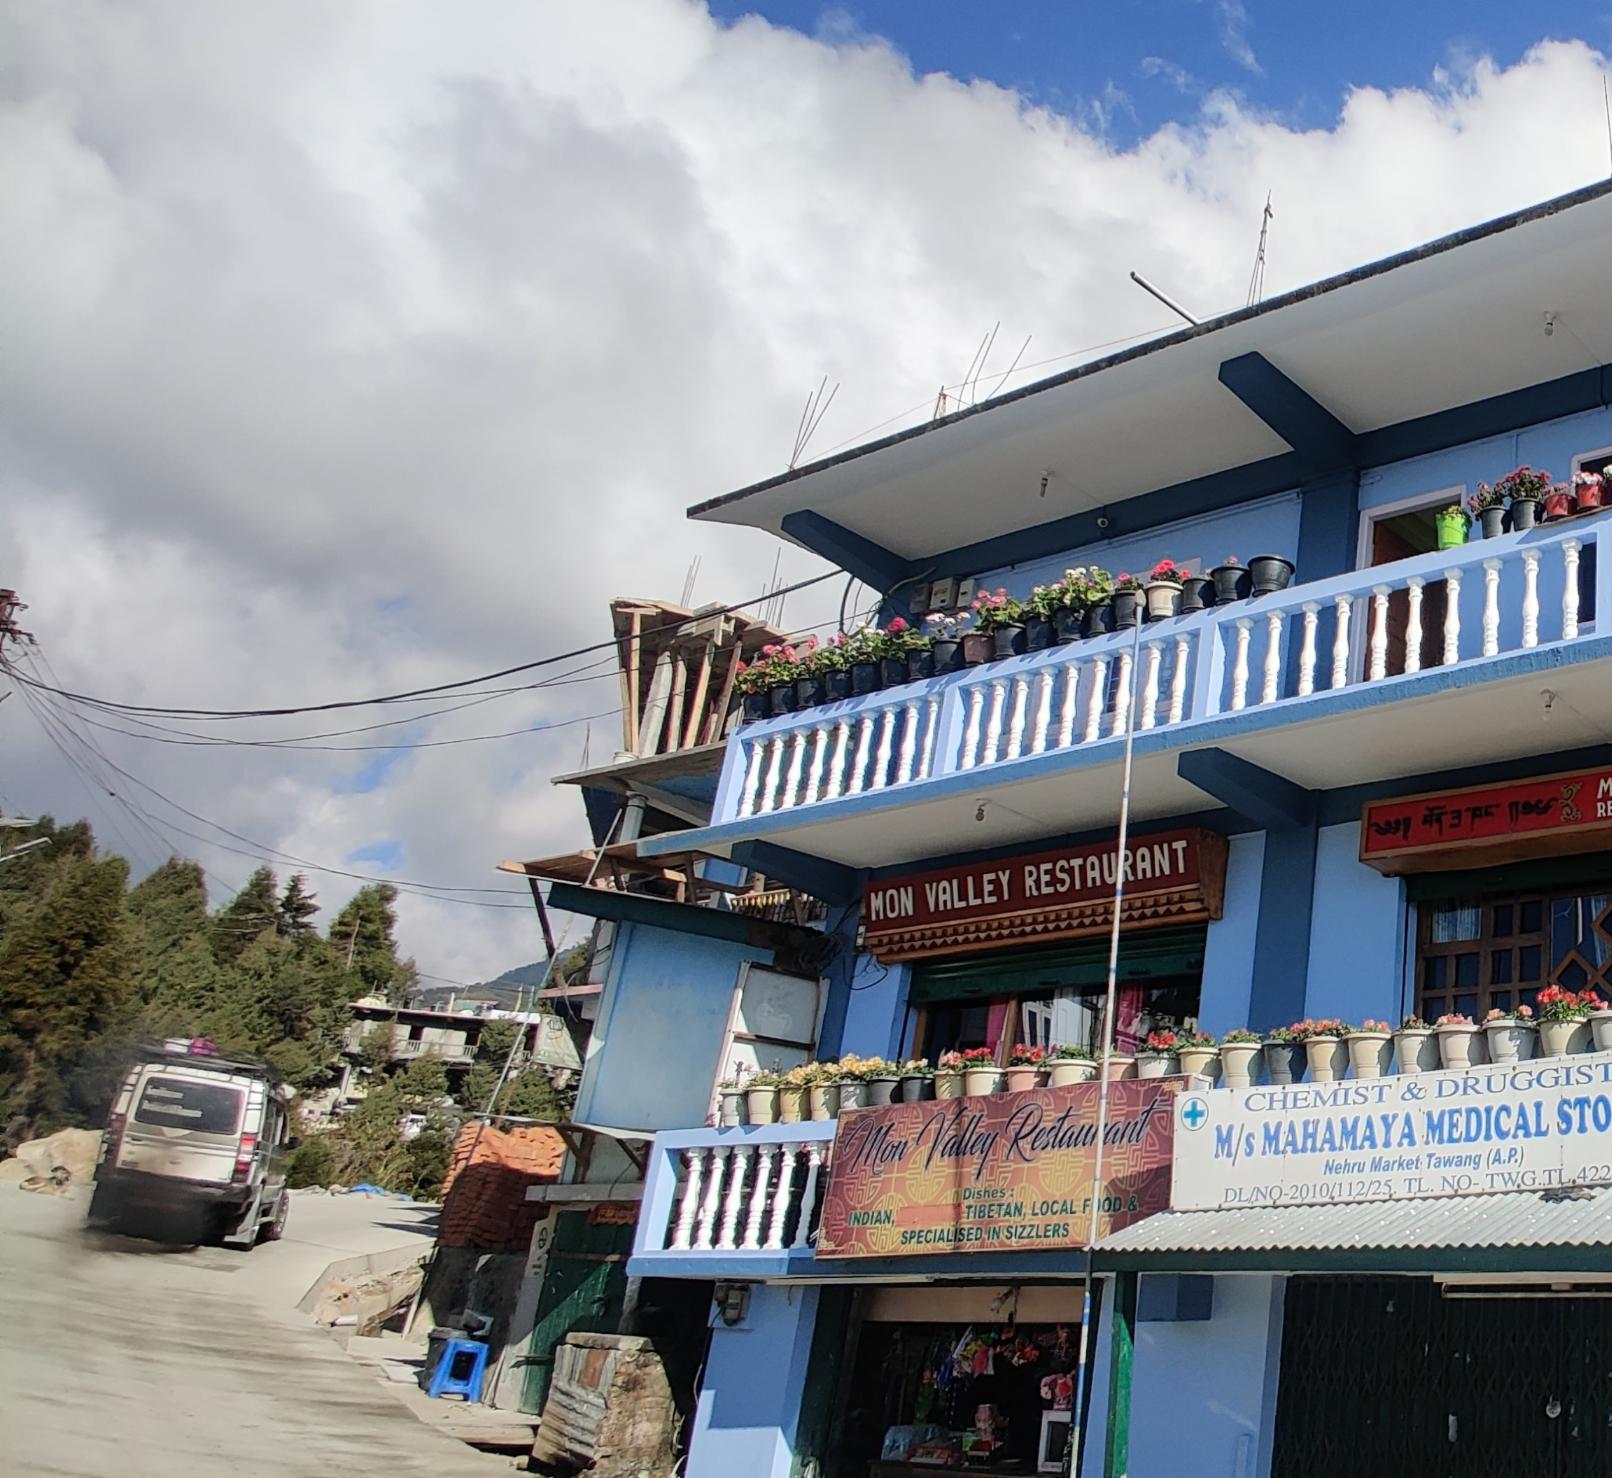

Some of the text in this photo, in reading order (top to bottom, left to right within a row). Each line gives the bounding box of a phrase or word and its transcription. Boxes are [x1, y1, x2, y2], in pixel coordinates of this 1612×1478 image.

[870, 839, 1188, 921] MON VALLEY RESTAURANT
[1244, 1083, 1392, 1112] CHEMIST
[1400, 1081, 1427, 1101] &
[843, 1117, 909, 1176] Mon
[916, 1106, 999, 1181] Valley
[1214, 1122, 1255, 1167] M/s
[1261, 1111, 1417, 1156] MAHAMAYA
[1424, 1100, 1550, 1146] MEDICAL
[1323, 1159, 1366, 1175] Nehru
[1370, 1154, 1421, 1172] Market
[1426, 1152, 1482, 1169] Tawang
[1031, 1200, 1077, 1216] LOCAL
[1083, 1196, 1122, 1214] FOD
[1128, 1196, 1138, 1211] &
[901, 1223, 1070, 1245] SPECIALISED IN SIZZLERS
